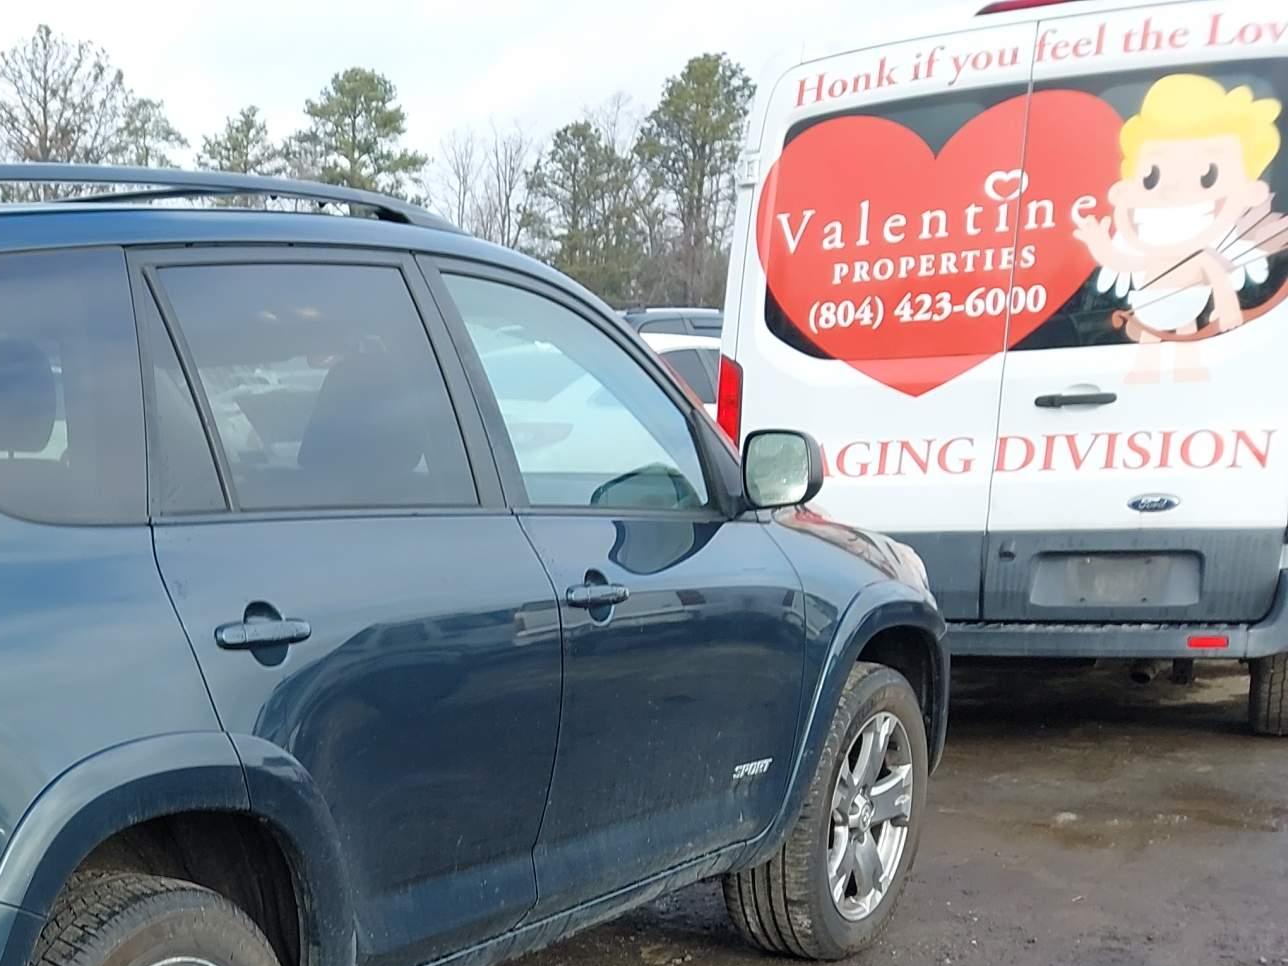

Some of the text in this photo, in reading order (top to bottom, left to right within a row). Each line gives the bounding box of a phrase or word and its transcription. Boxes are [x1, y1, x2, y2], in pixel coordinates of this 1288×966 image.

[794, 56, 899, 108] Honk
[911, 45, 946, 82] if
[947, 46, 1020, 87] you
[1035, 22, 1107, 62] feel
[1122, 16, 1190, 53] the
[776, 193, 1098, 255] Valentine
[831, 244, 1036, 285] PROPERTIES
[808, 285, 1048, 334] (804) 423-6000
[994, 428, 1279, 473] DIVISION
[732, 757, 773, 779] SPORT
